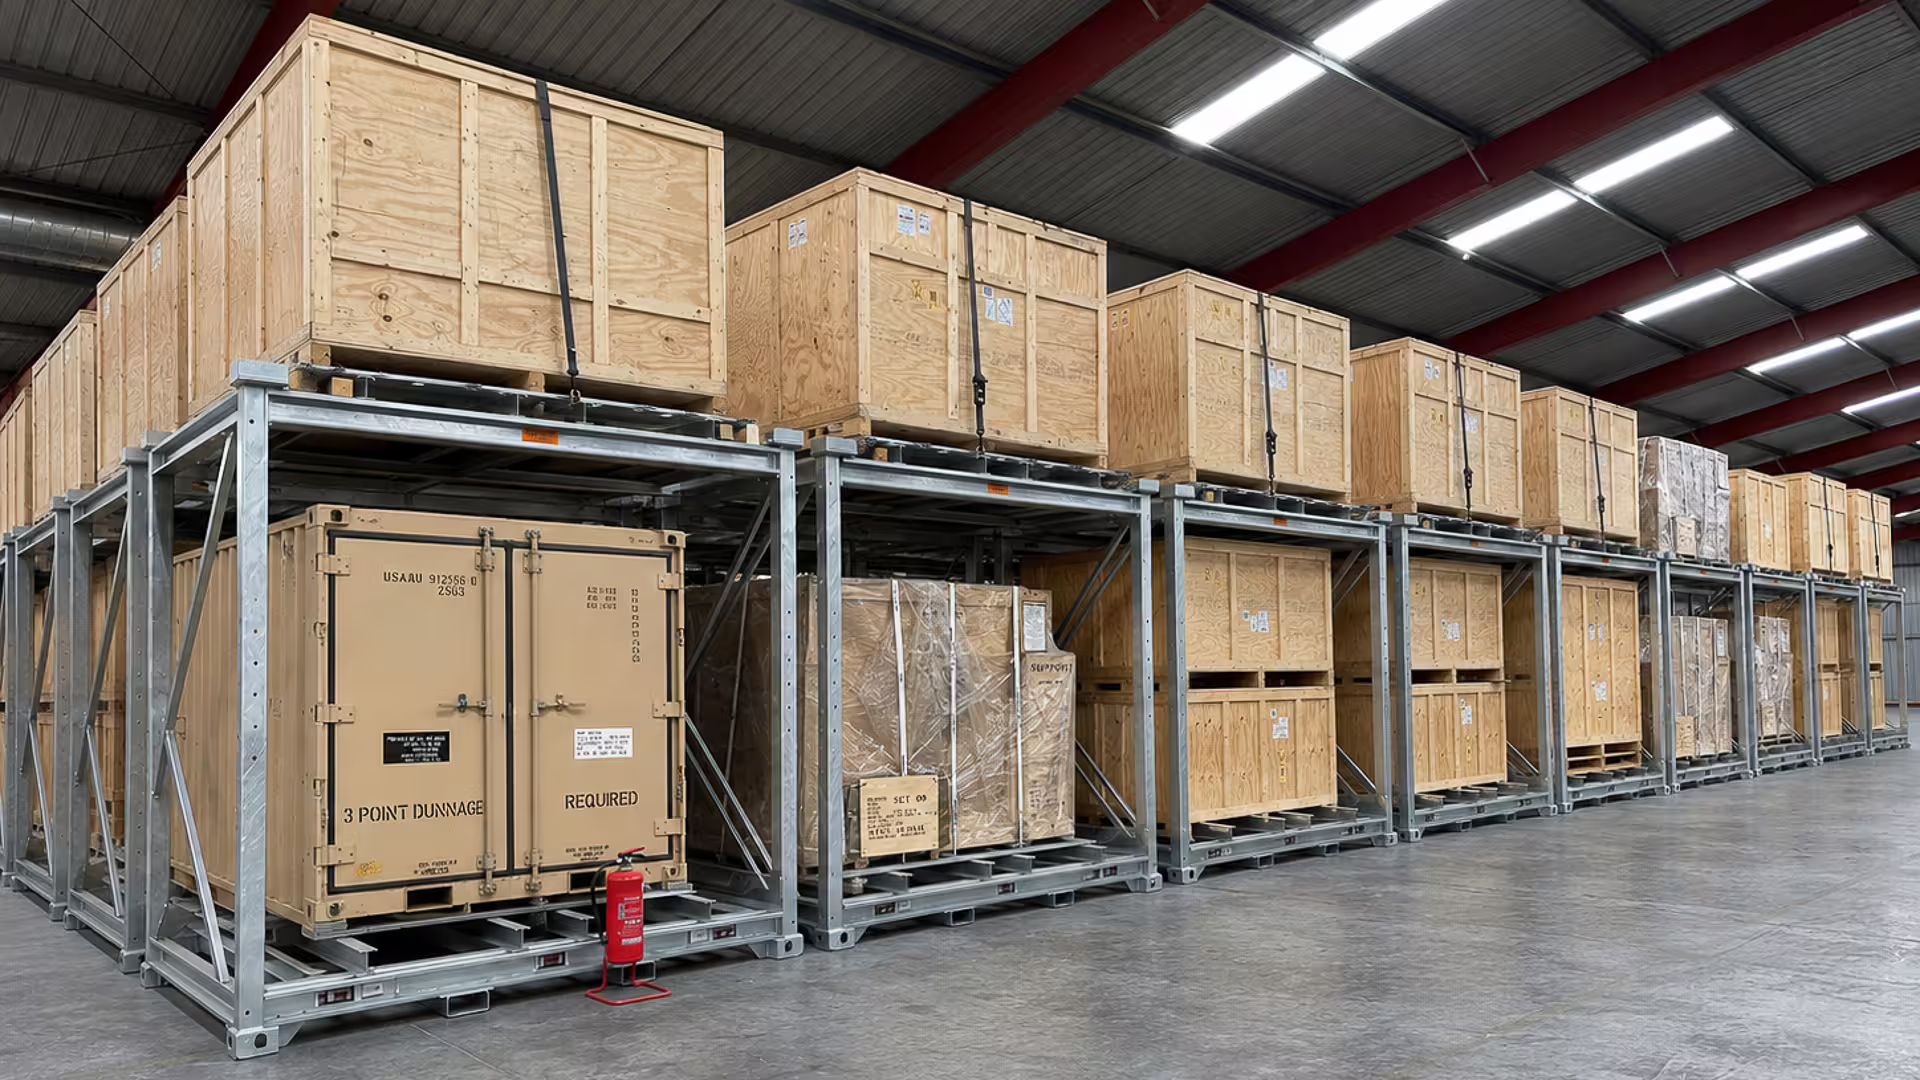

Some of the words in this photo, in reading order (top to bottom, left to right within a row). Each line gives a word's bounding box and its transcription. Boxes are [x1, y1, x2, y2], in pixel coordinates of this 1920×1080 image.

[565, 790, 639, 809] REQUIRED
[344, 807, 353, 823] 3
[358, 804, 408, 823] POINT
[413, 799, 484, 819] DUNNAGE
